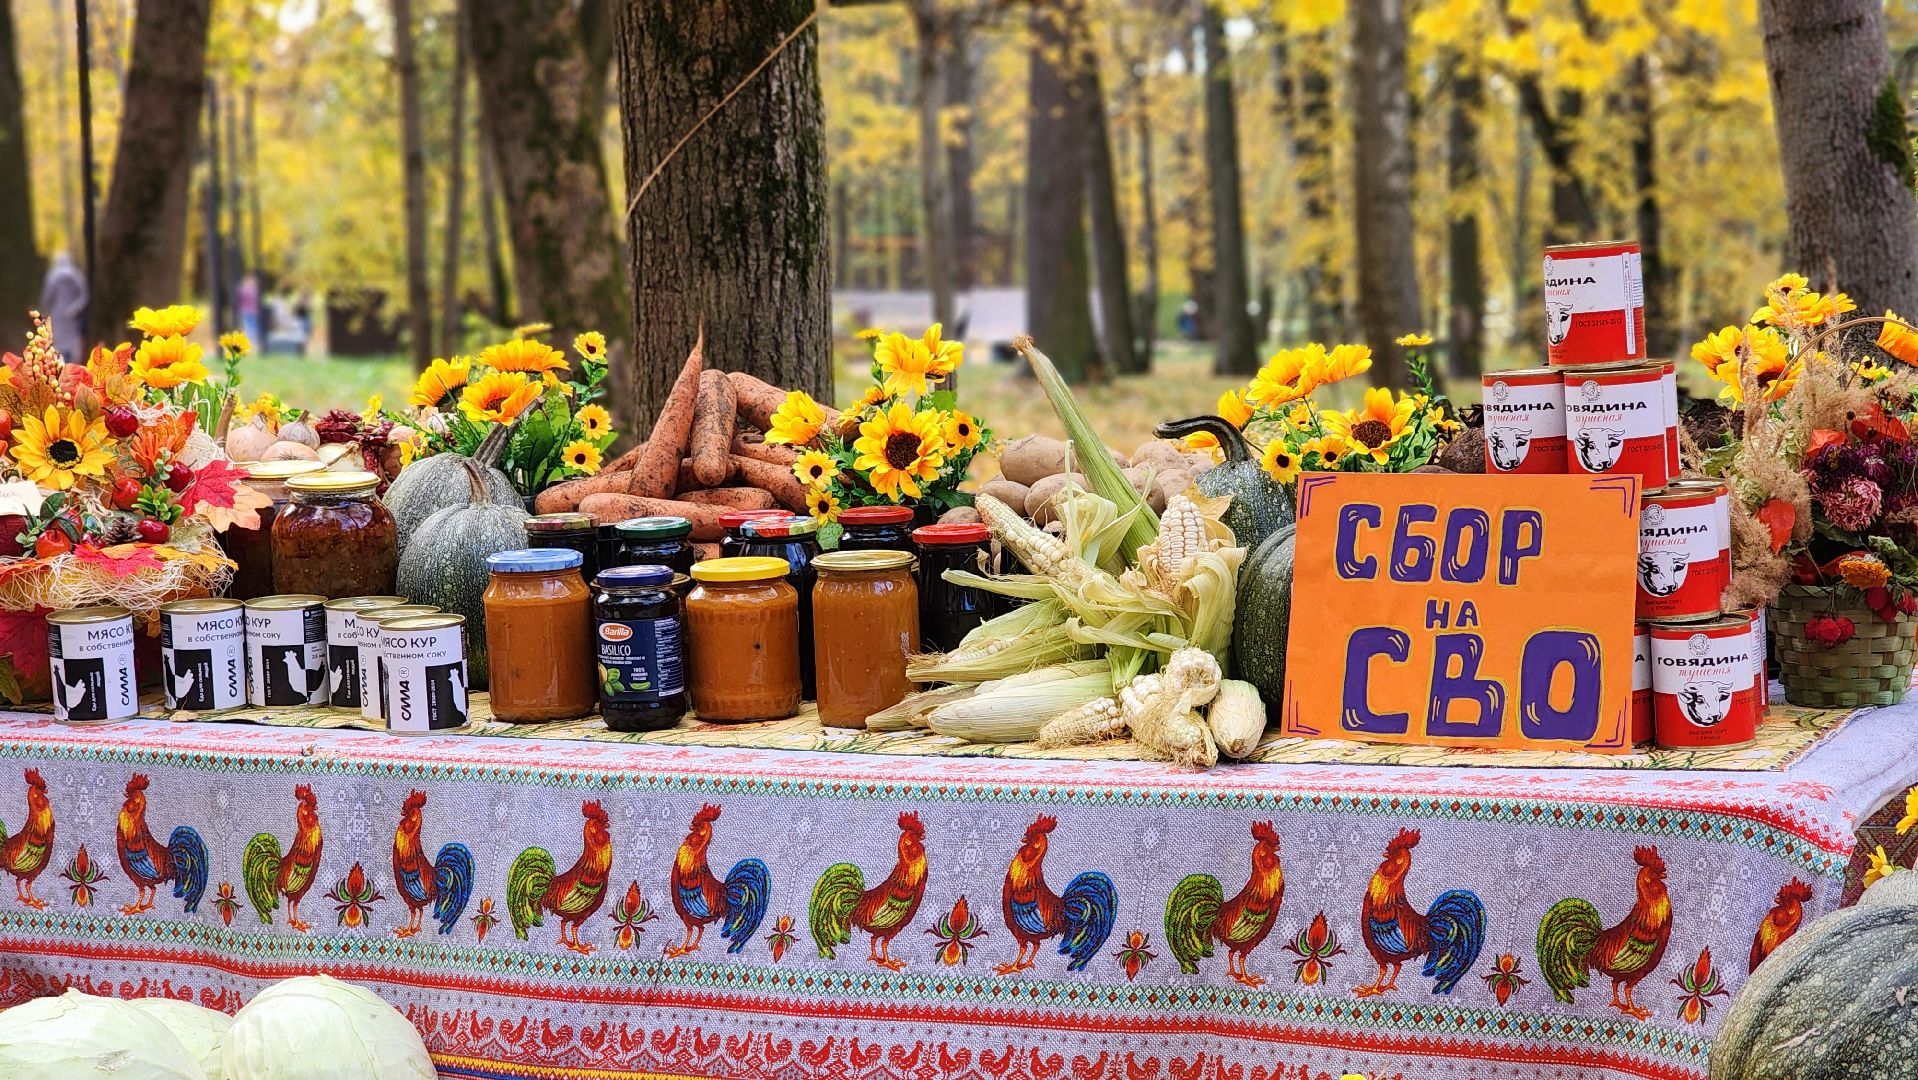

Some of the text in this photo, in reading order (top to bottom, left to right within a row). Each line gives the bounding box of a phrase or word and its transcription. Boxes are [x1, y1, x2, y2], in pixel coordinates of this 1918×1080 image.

[1334, 503, 1546, 588] СБОР
[1425, 597, 1481, 631] НА
[196, 618, 234, 633] МЯСО
[251, 616, 272, 629] КУР
[87, 626, 125, 641] МЯСО
[262, 632, 281, 641] соку
[604, 627, 630, 637] Barilla
[410, 636, 437, 649] КУР
[426, 650, 447, 659] соку
[600, 643, 632, 657] BASILICO
[1657, 653, 1749, 668] ГОВЯДИНА
[1340, 625, 1606, 744] СВО
